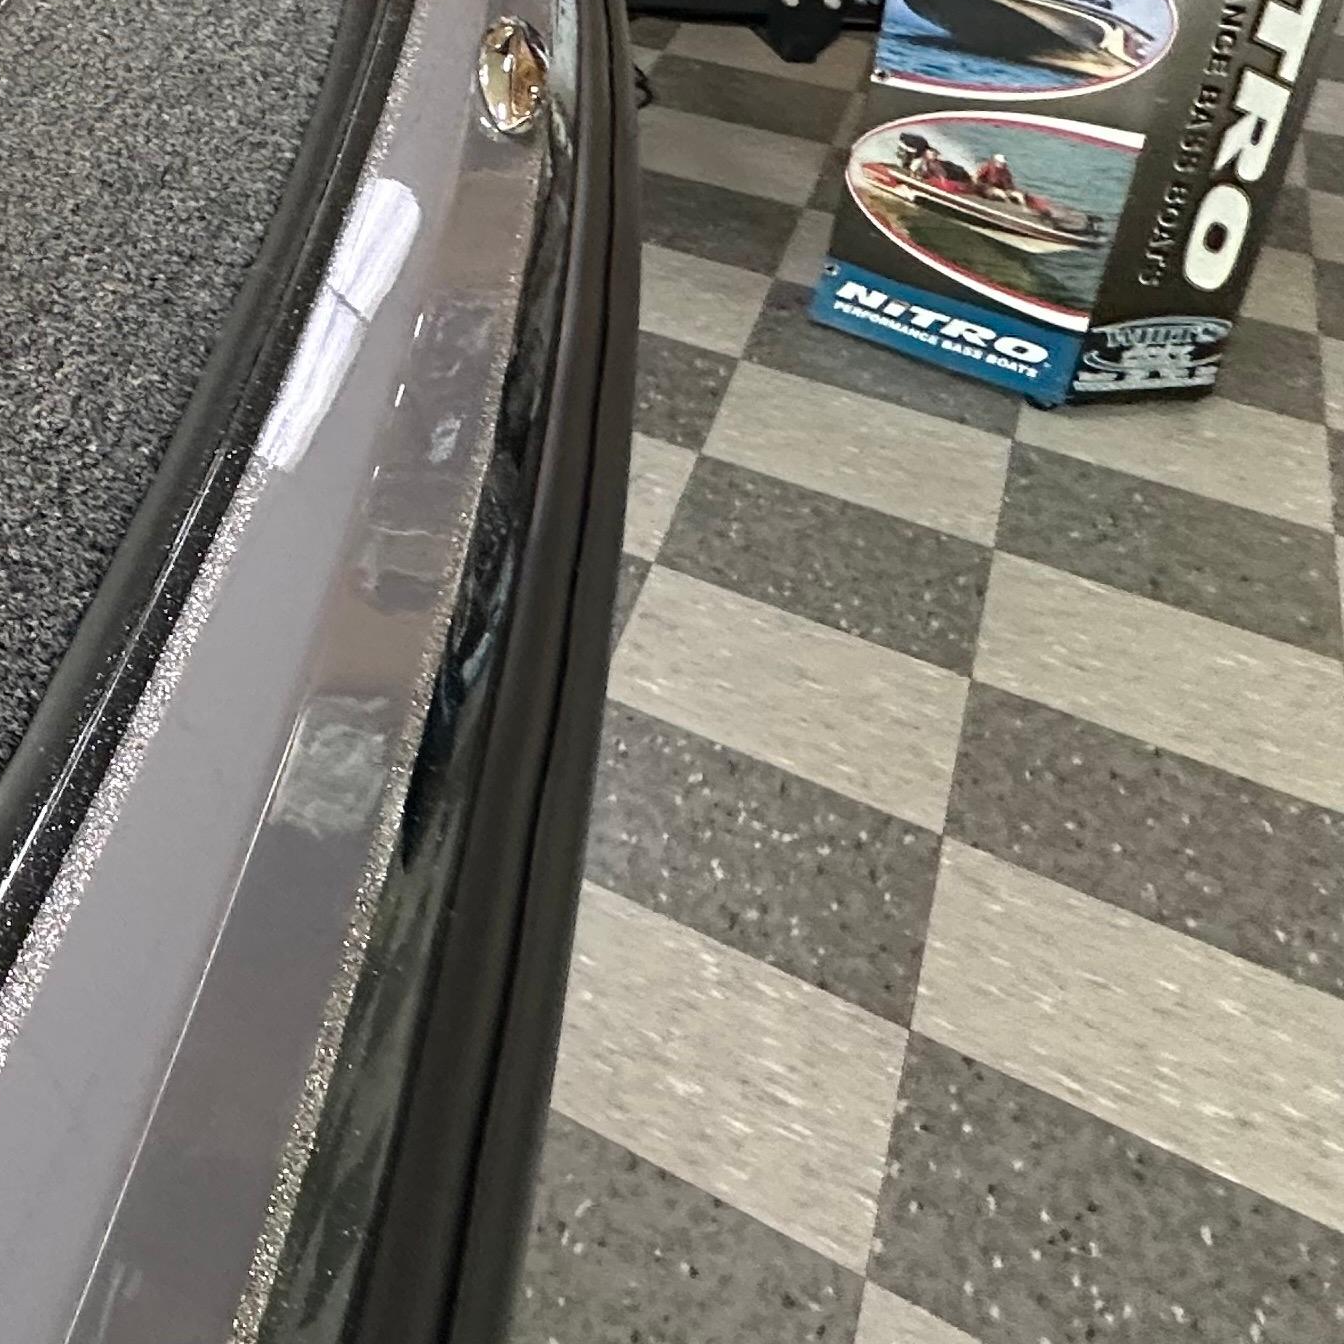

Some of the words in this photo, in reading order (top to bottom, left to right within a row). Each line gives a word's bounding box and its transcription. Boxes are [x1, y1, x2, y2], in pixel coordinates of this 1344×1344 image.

[1172, 83, 1222, 174] BASS
[1137, 181, 1190, 288] BOATS
[832, 300, 938, 346] PERFORMANCE
[940, 339, 983, 361] BASS
[985, 353, 1039, 379] BOATS
